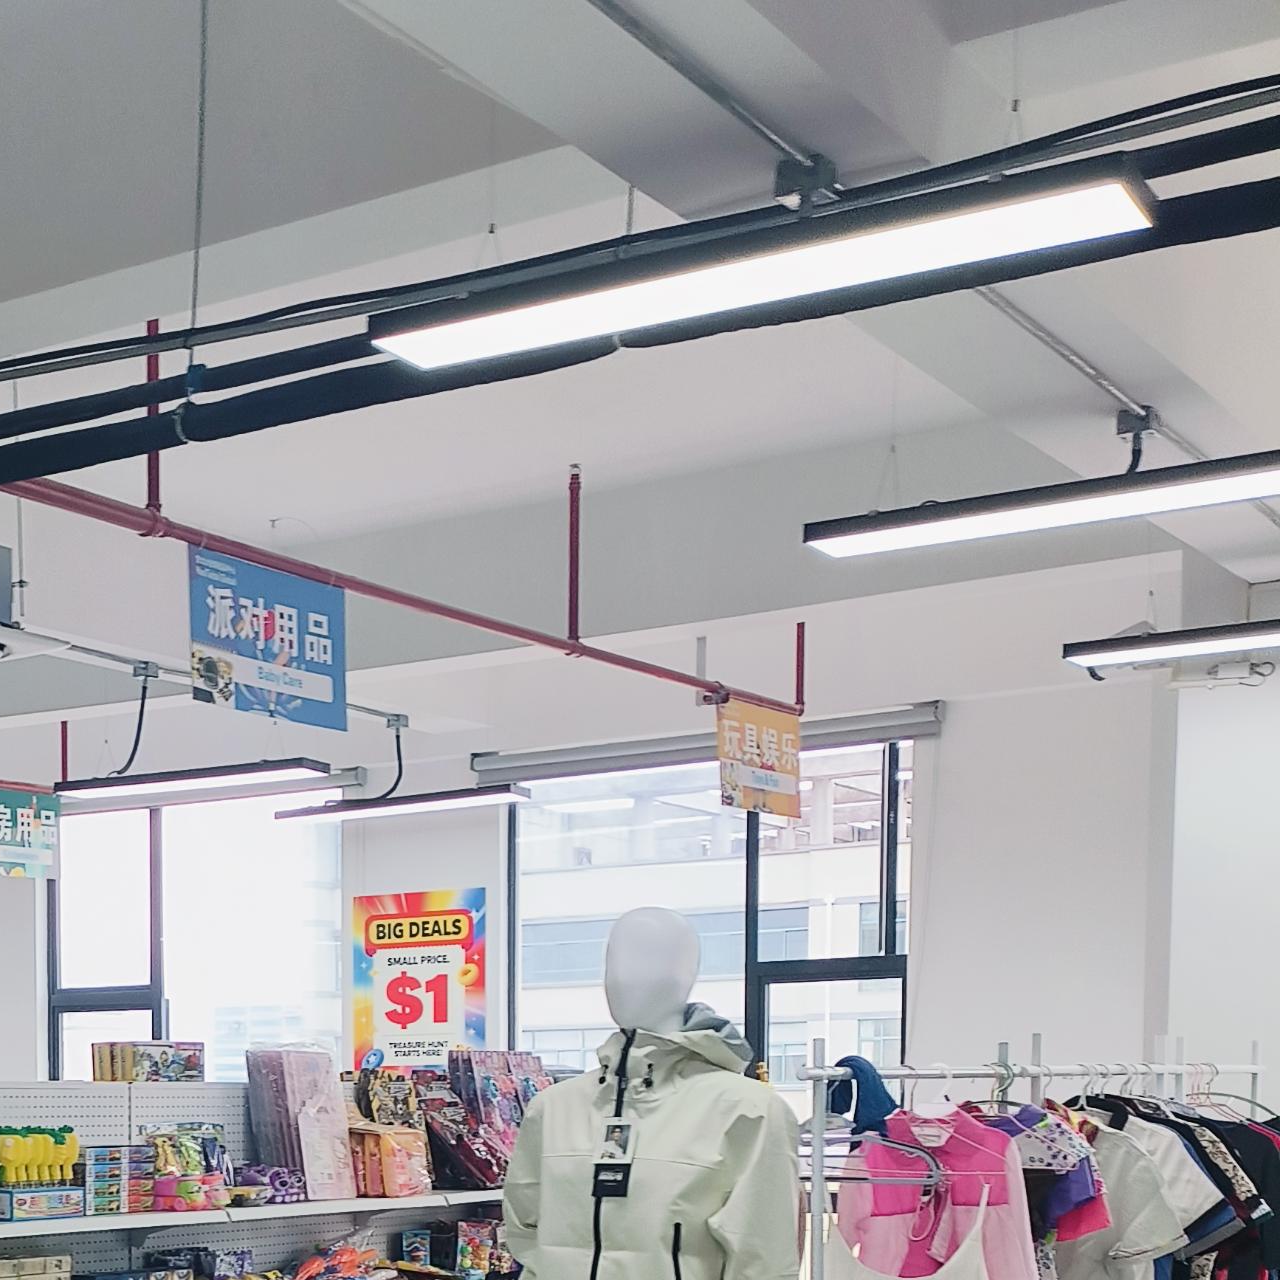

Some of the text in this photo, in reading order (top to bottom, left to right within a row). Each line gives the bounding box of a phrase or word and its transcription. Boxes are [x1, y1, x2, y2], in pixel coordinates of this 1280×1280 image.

[206, 584, 332, 664] 派对用品
[375, 918, 463, 940] BIG DEALS
[387, 954, 450, 967] SMALL PRICE
[384, 971, 449, 1029] $1
[389, 1040, 449, 1050] TREASURE HUNT
[394, 1050, 421, 1058] STARTS
